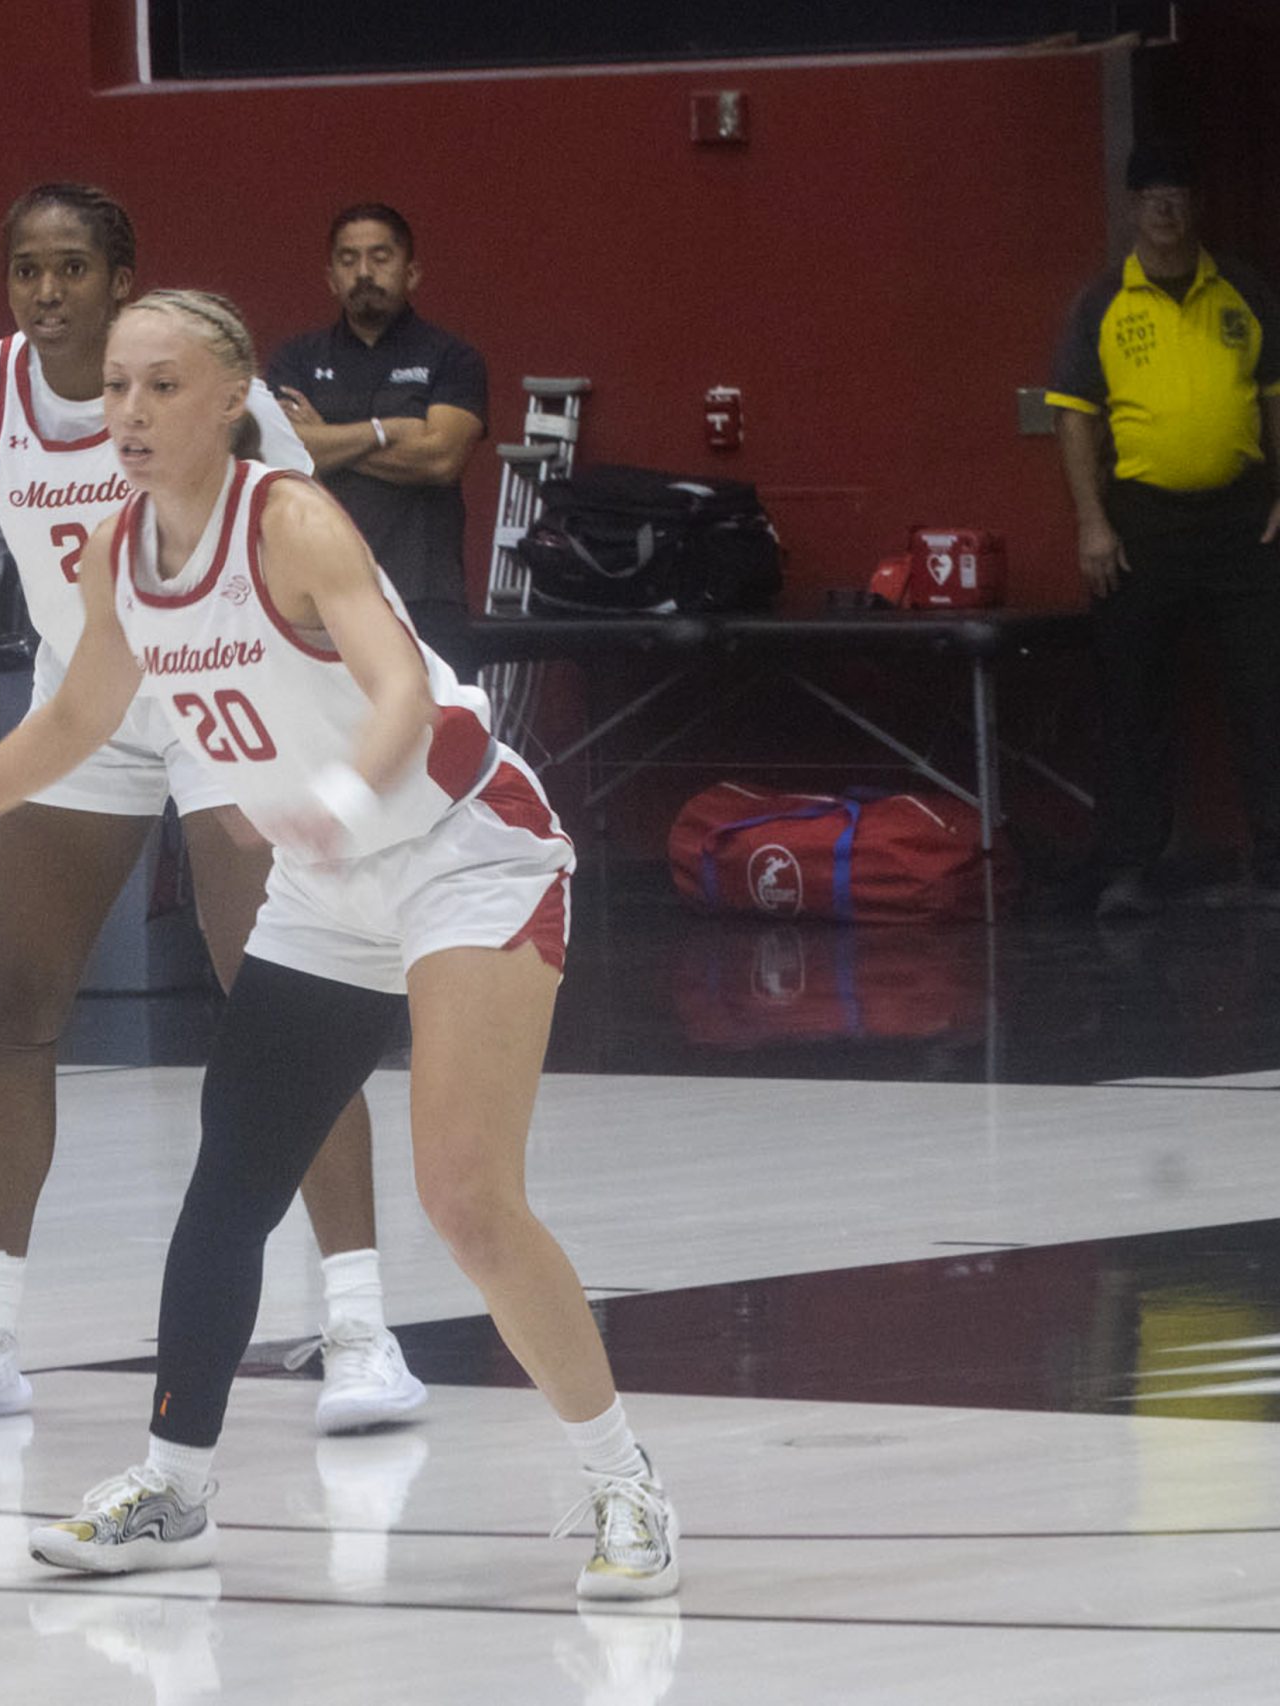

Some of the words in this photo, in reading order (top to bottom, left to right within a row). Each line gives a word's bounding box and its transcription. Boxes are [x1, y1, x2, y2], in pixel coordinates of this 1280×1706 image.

[9, 472, 131, 508] Matado
[137, 637, 267, 676] Matadors
[172, 689, 277, 762] 20
